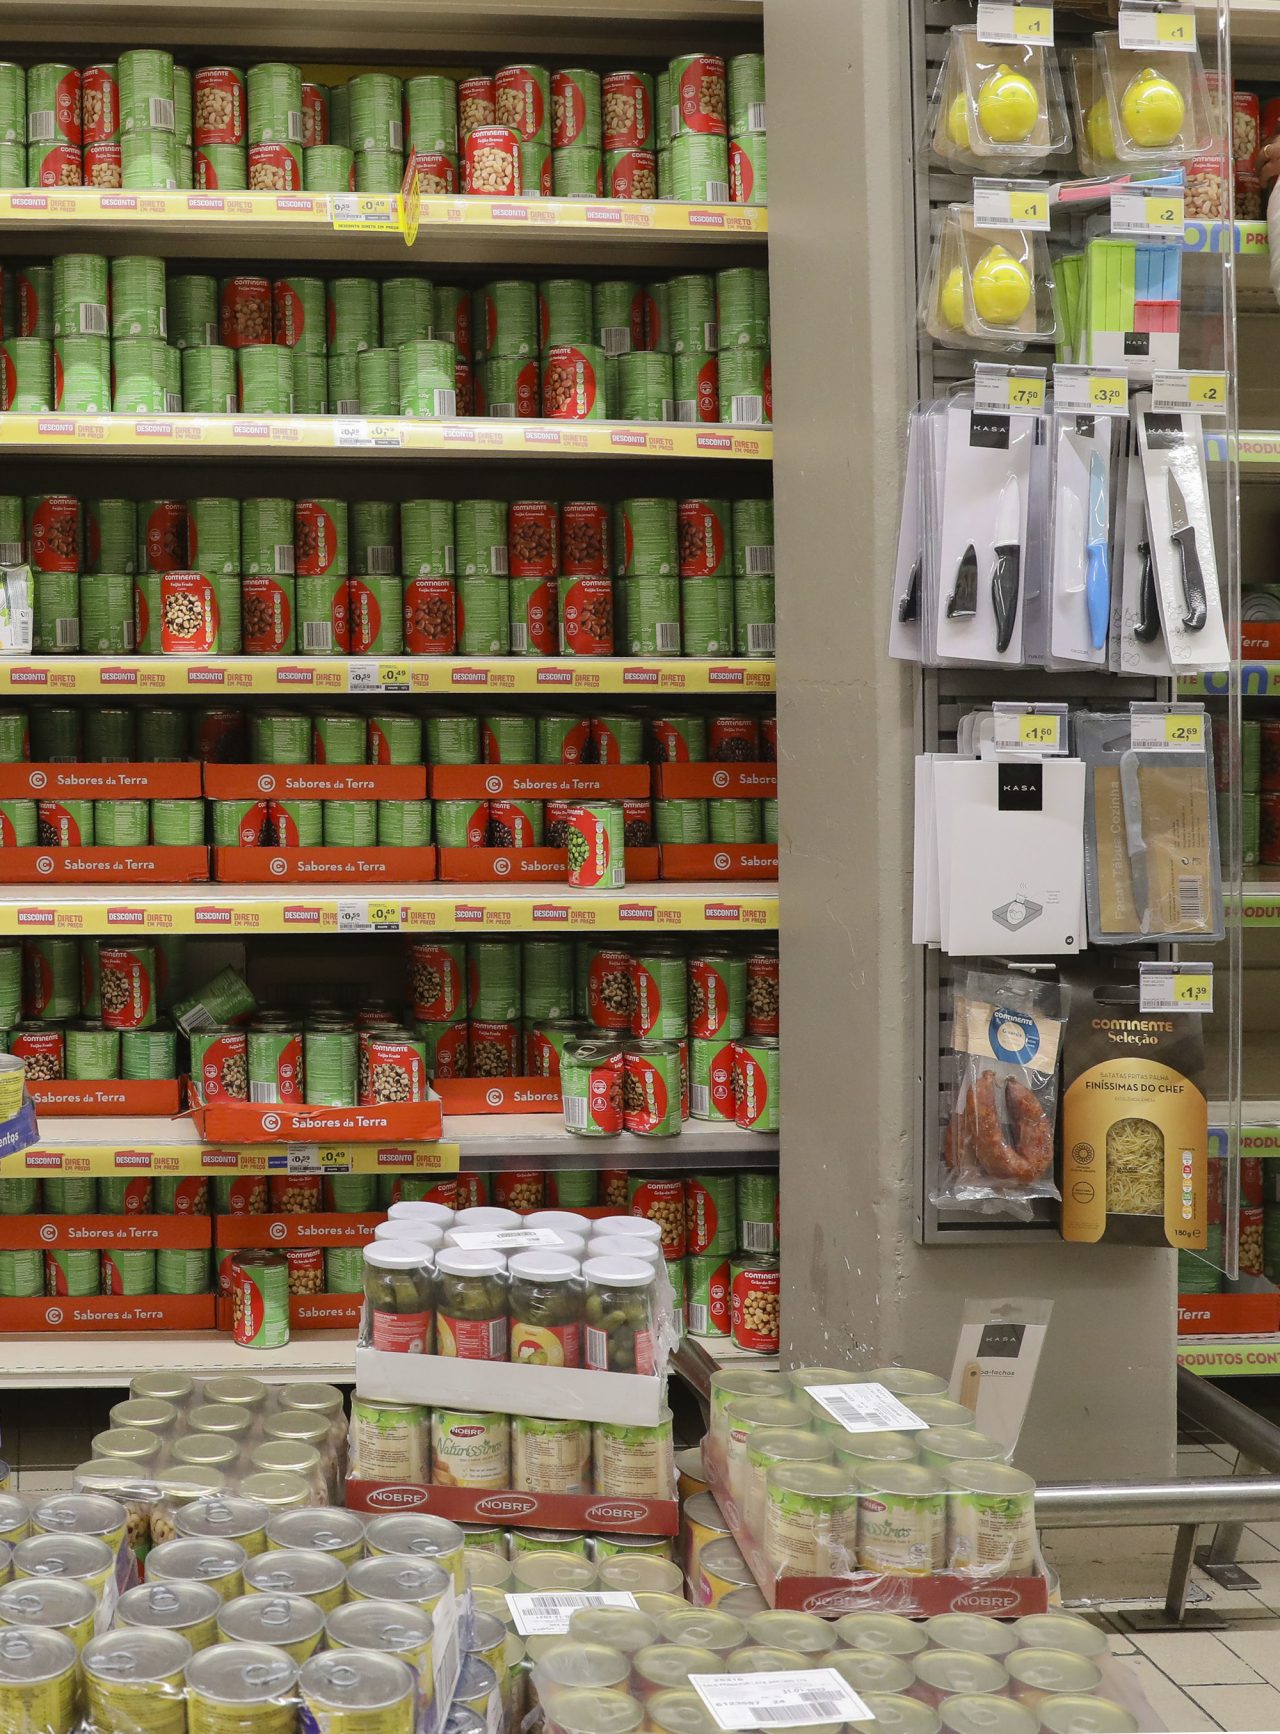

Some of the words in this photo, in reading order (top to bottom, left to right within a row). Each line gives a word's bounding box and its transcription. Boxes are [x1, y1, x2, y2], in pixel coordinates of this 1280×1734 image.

[1024, 204, 1038, 216] €1
[1160, 208, 1174, 221] €2
[1013, 389, 1038, 404] €7,50
[1094, 388, 1120, 404] €3,20
[1203, 388, 1217, 400] €2
[973, 424, 1006, 434] KASA
[189, 672, 222, 682] DESCONTO
[382, 669, 406, 682] €0,49
[453, 673, 486, 682] DESCONTO
[710, 672, 743, 681] DESCONTO
[1026, 728, 1052, 742] €1,60
[1172, 727, 1198, 742] €2,69
[57, 774, 102, 786] Sabores
[106, 776, 116, 786] da
[118, 774, 148, 786] Terra
[286, 777, 330, 789] Sabores
[334, 780, 344, 788] da
[346, 779, 375, 789] Terra
[513, 778, 558, 790] Sabores
[560, 780, 570, 790] da
[572, 779, 600, 790] Terra
[1004, 784, 1037, 792] KASA
[64, 858, 110, 870] Sabores
[112, 862, 123, 870] da
[125, 860, 155, 870] Terra
[298, 861, 342, 873] Sabores
[346, 864, 356, 872] da
[357, 861, 386, 872] Terra
[520, 860, 566, 872] Sabores
[109, 913, 143, 922] DESCONTO
[372, 908, 396, 922] €0,49
[534, 910, 567, 918] DESCONTO
[705, 909, 738, 918] DESCONTO
[1180, 987, 1207, 1000] €1,39
[1092, 1018, 1174, 1032] CONTINENTE
[1108, 1032, 1158, 1046] Seleção
[1086, 1078, 1138, 1092] FINÍSSIMAS
[1140, 1084, 1156, 1092] DO
[1158, 1084, 1185, 1094] CHEF
[34, 1092, 80, 1104] Sabores
[84, 1094, 94, 1102] da
[96, 1092, 126, 1103] Terra
[514, 1090, 558, 1102] Sabores
[292, 1116, 340, 1129] Sabores
[344, 1118, 354, 1128] da
[356, 1116, 388, 1128] Terra
[26, 1158, 61, 1166] DESCONTO
[116, 1156, 150, 1165] DESCONTO
[379, 1154, 412, 1163] DESCONTO
[68, 1227, 114, 1239] Sabores
[129, 1228, 158, 1238] Terra
[134, 1309, 164, 1320] Terra
[372, 1491, 423, 1504] NOBRE
[481, 1500, 532, 1511] NOBRE
[591, 1507, 643, 1520] NOBRE
[958, 1594, 1014, 1608] NOBRE
